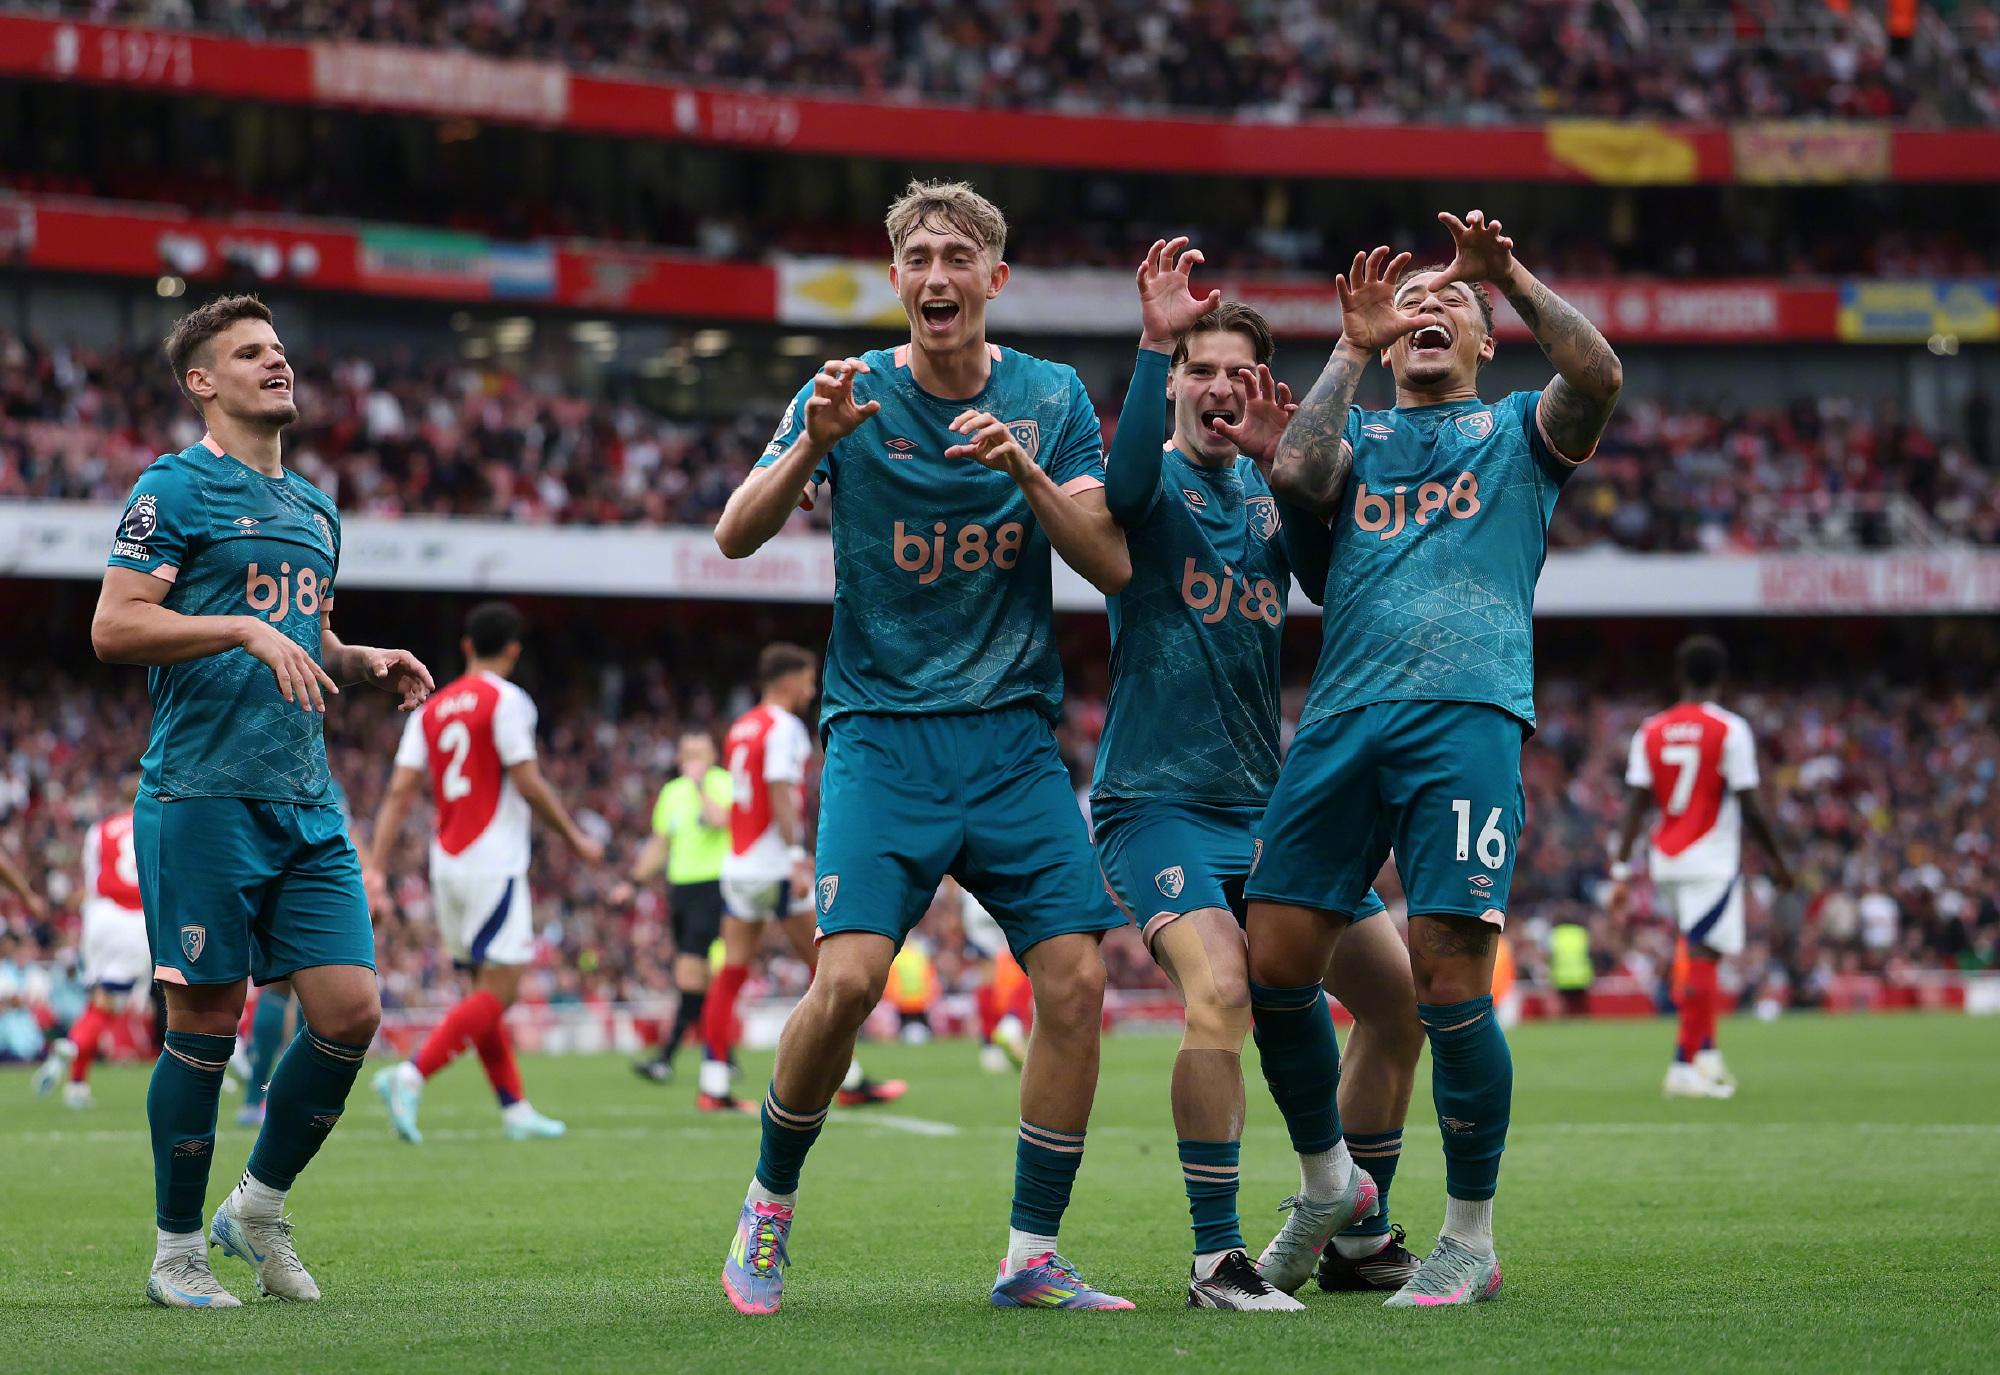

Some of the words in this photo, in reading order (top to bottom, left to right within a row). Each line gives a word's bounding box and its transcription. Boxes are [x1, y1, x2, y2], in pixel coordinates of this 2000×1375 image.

[1354, 471, 1481, 541] bj88
[893, 521, 1024, 585] bj88
[1181, 557, 1281, 625] bj88
[438, 719, 471, 802] 2
[1661, 745, 1700, 816] 7
[1452, 800, 1506, 870] 16
